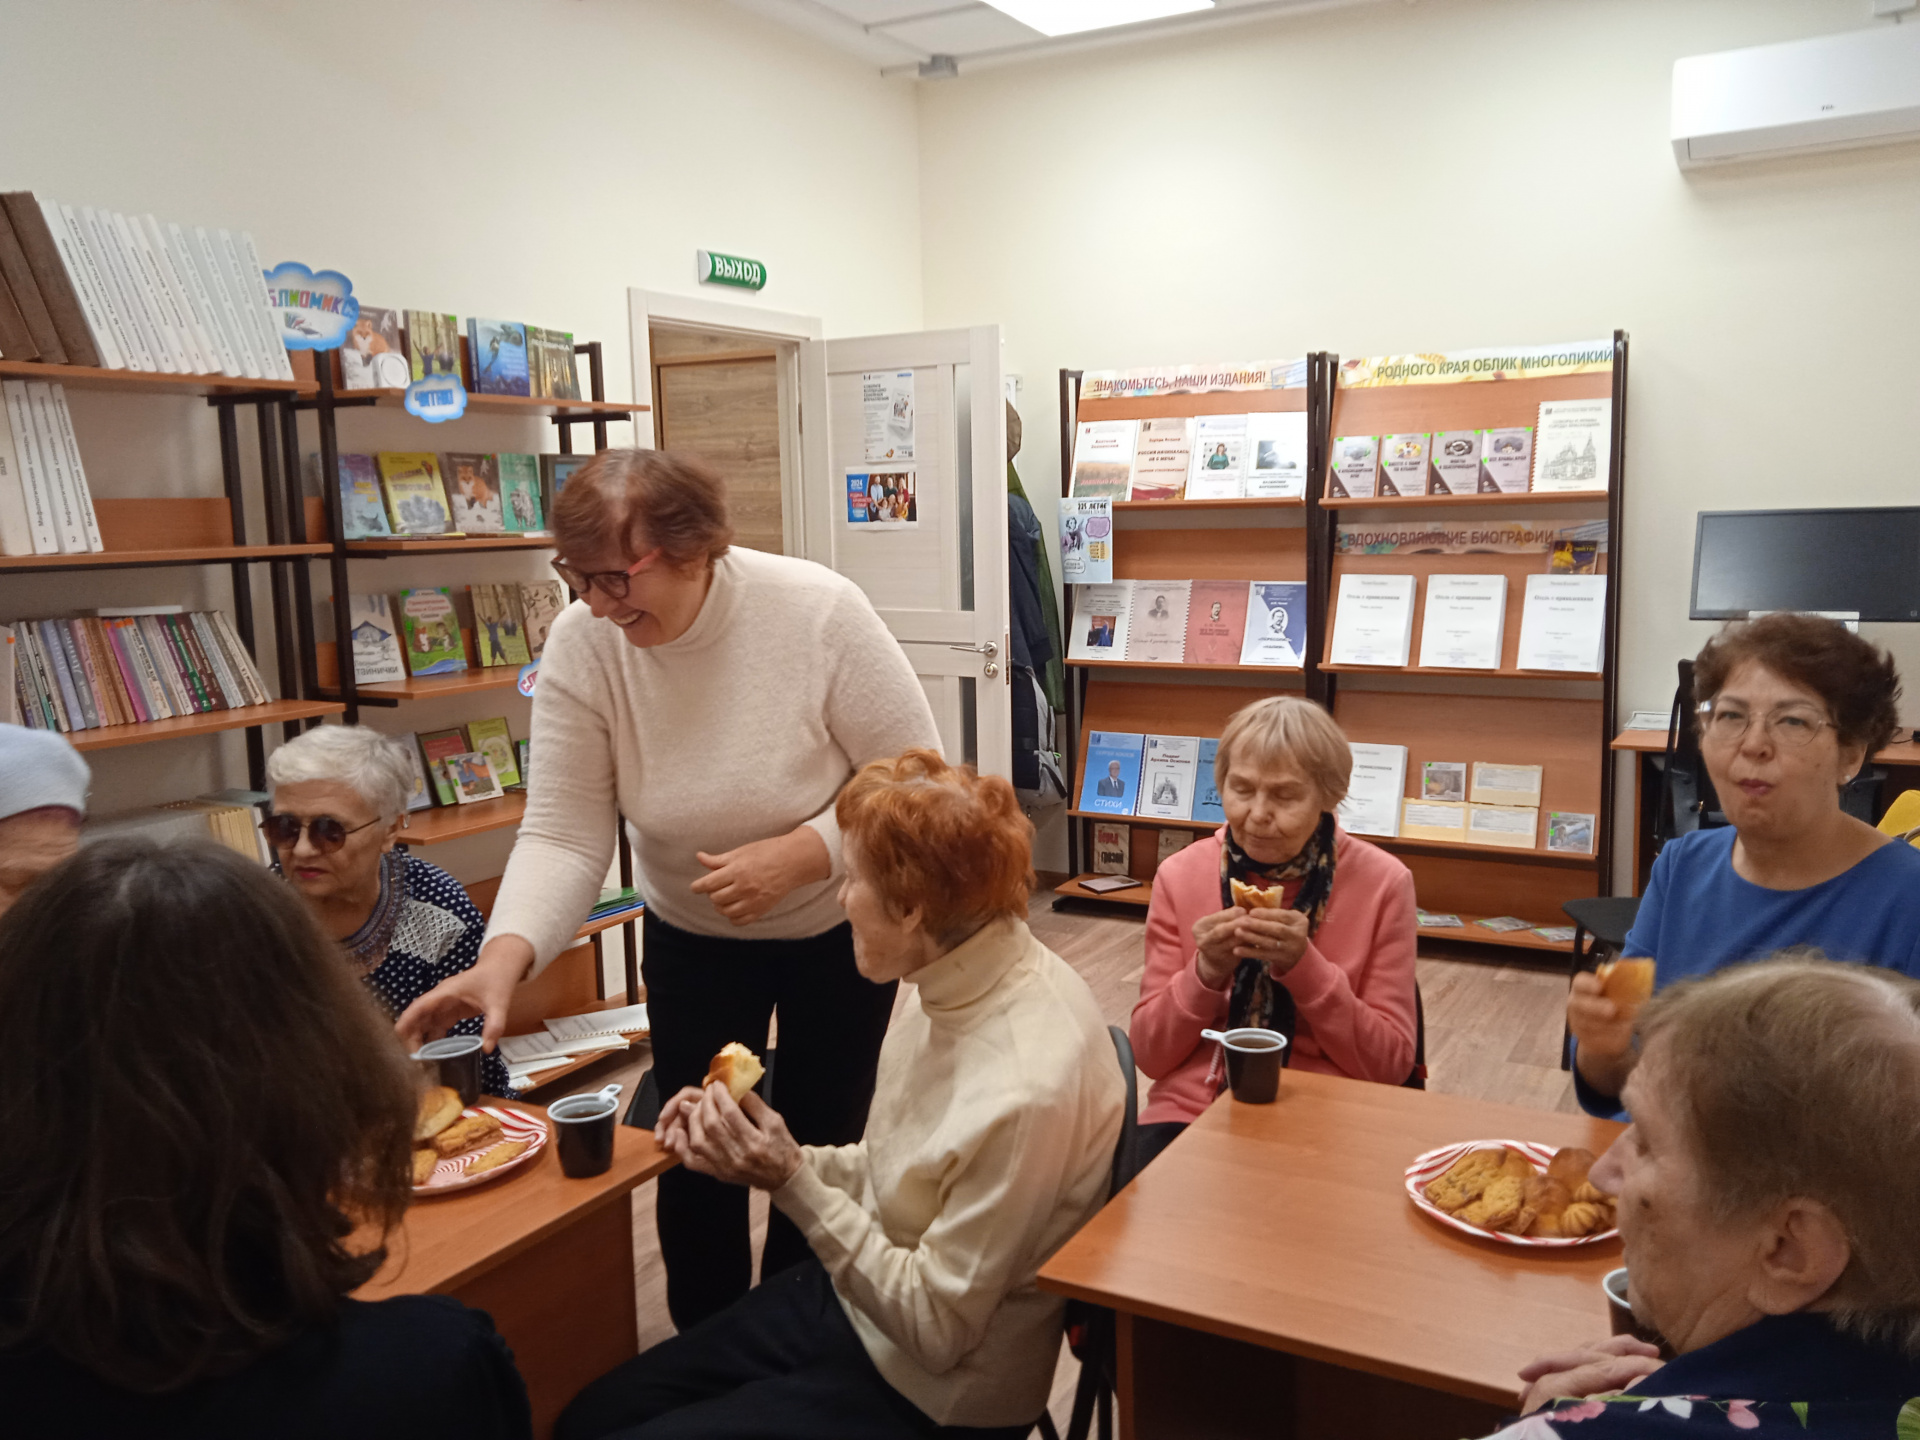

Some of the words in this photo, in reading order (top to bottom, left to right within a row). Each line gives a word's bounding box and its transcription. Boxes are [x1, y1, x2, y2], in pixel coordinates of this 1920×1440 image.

[714, 255, 761, 285] ВЫХОД
[1377, 362, 1436, 379] РОДНОГО
[1439, 360, 1470, 375] КРАЯ
[1473, 356, 1517, 372] ОБЛИК
[1521, 346, 1613, 369] МНОГОЛИКИЙ
[1093, 377, 1171, 392] ЗНАКОМЬТЕСЬ,
[1175, 375, 1207, 388] НАШИ
[1210, 371, 1266, 386] ИЗДАНИЯ!
[23, 436, 32, 464] словарь
[48, 437, 58, 465] словарь
[68, 438, 78, 466] словарь
[29, 467, 44, 526] Мифологический
[55, 468, 72, 526] Мифологический
[75, 469, 93, 526] Мифологический
[1348, 531, 1467, 547] ВДОХНОВЛЯЮЩИЕ
[1471, 530, 1553, 545] БИОГРАФИИ
[355, 666, 398, 675] тайнички
[1094, 799, 1122, 808] СТИХИ
